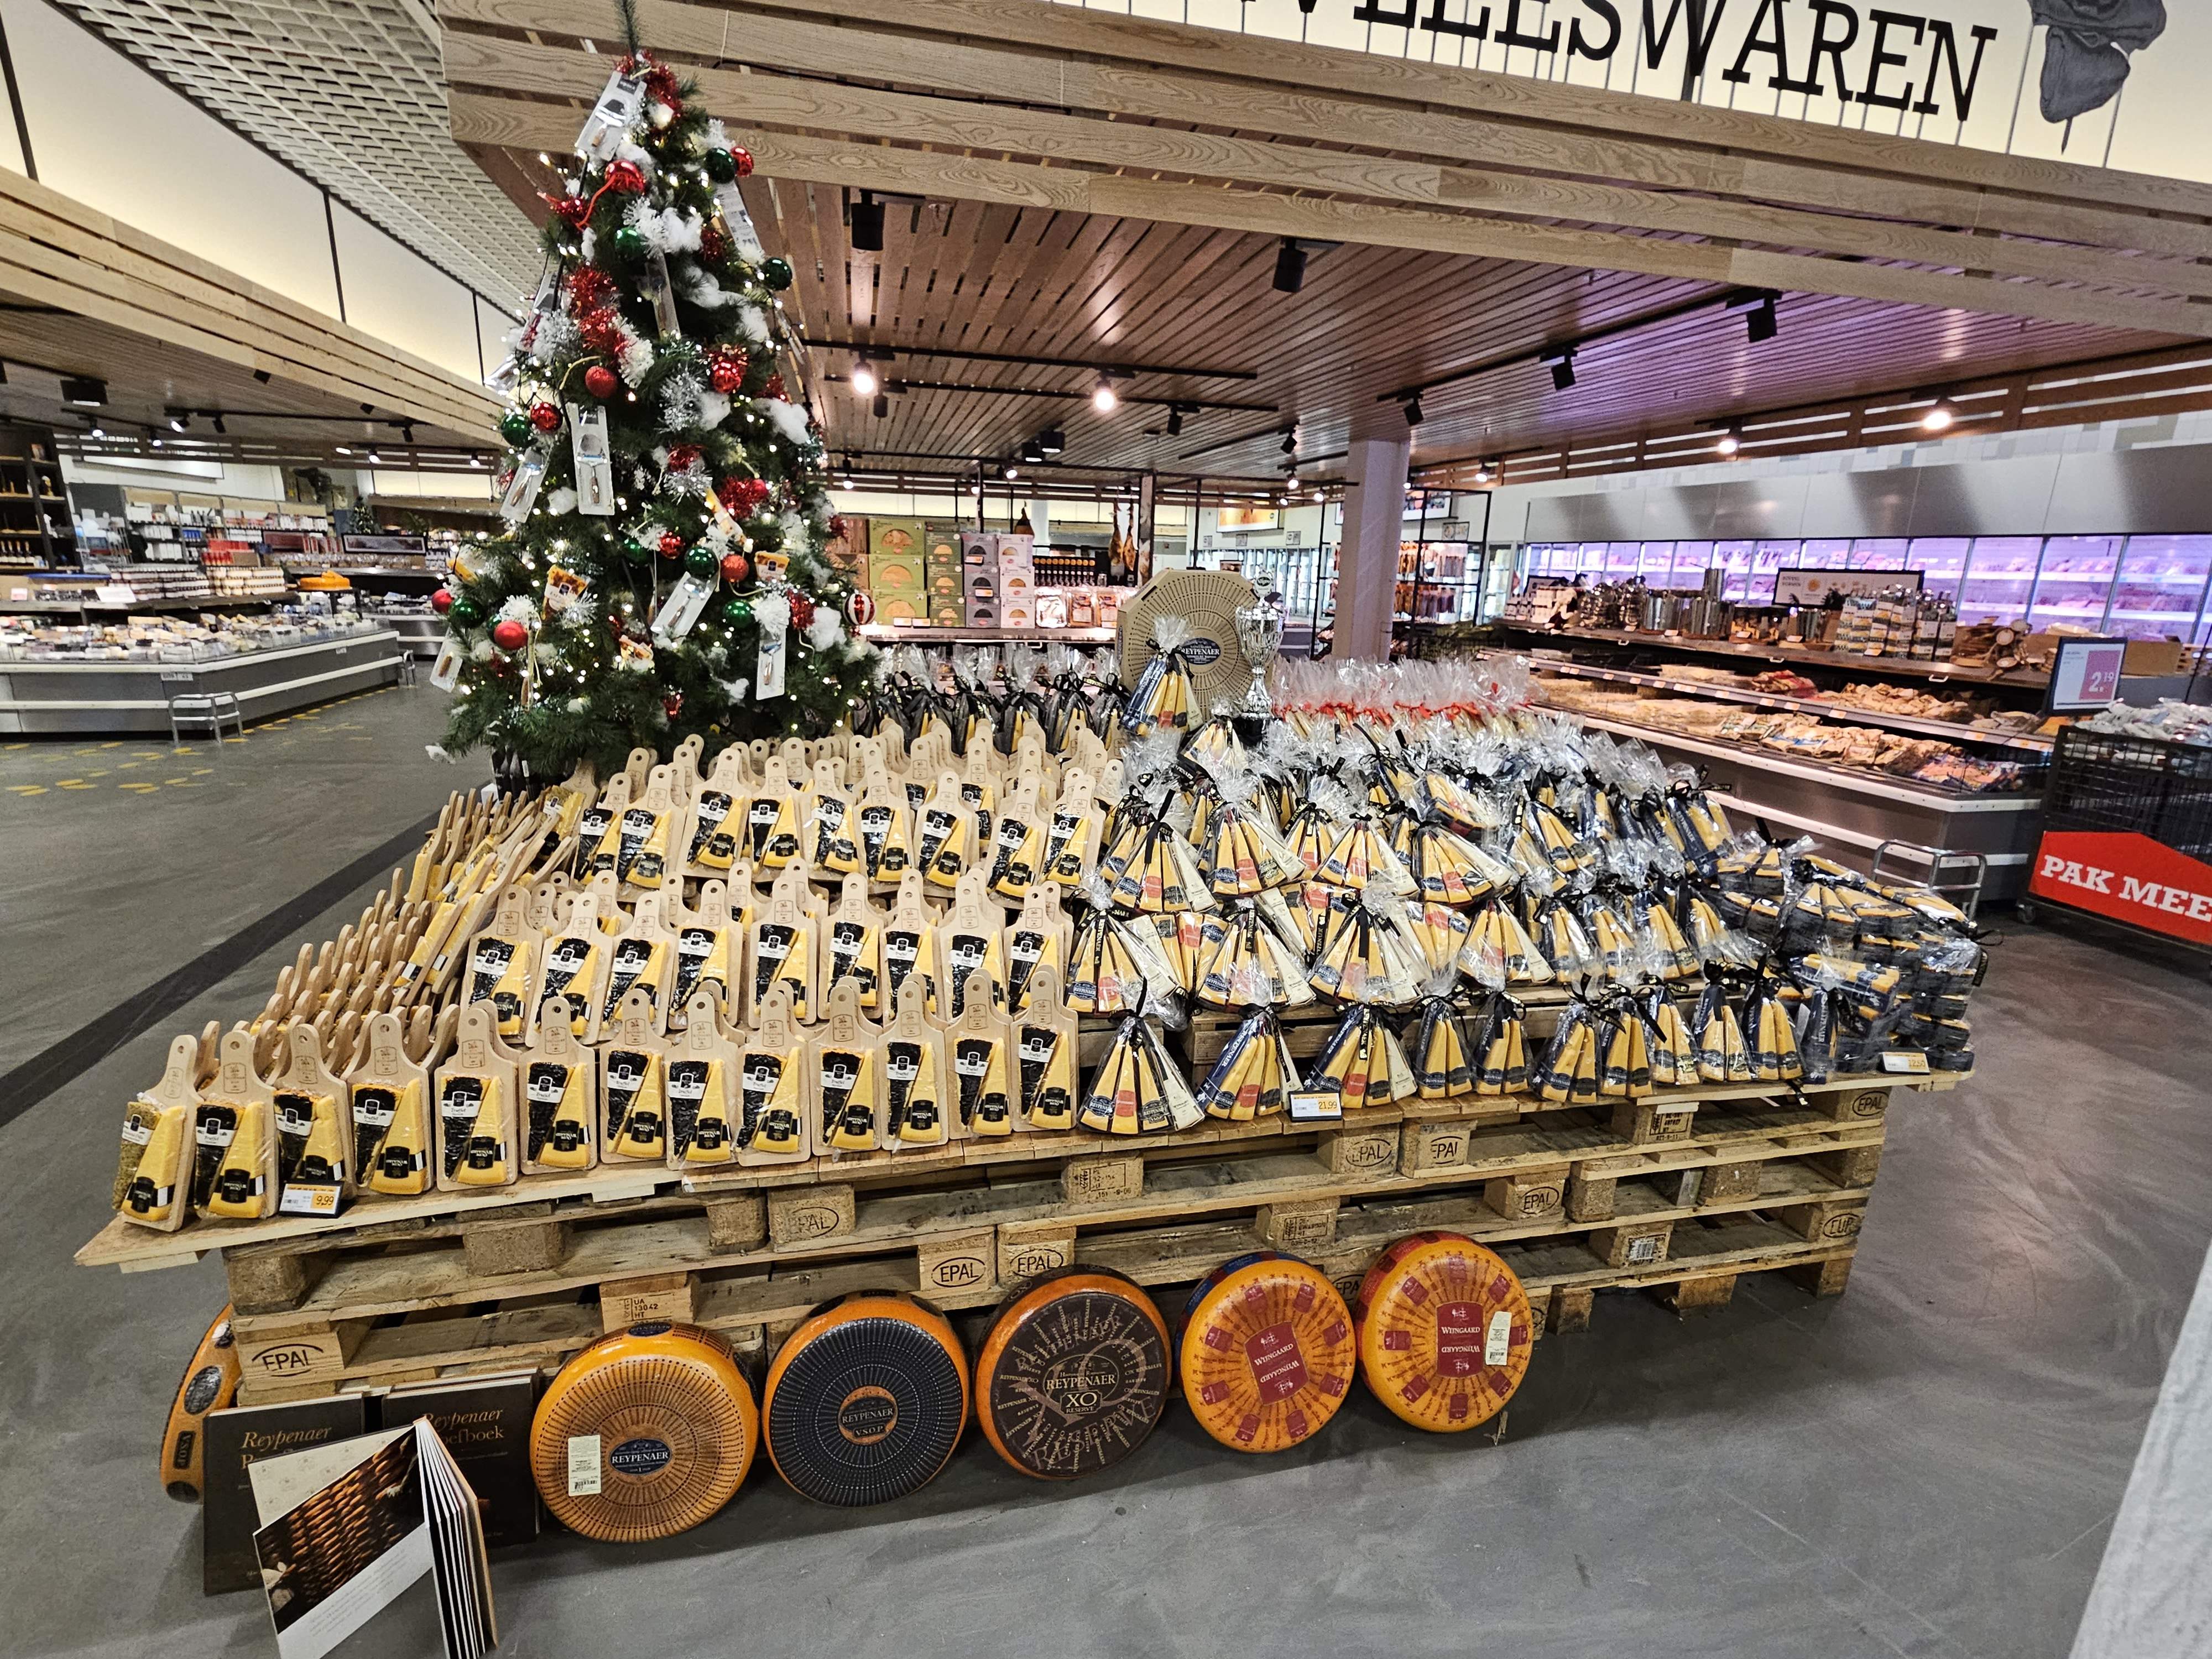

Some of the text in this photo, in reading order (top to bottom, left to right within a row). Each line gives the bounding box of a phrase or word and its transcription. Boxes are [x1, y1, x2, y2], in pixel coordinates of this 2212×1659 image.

[2040, 854, 2212, 922] PAK MEE
[1318, 1100, 1337, 1110] 21,99
[1858, 1096, 1884, 1111] EPAL
[316, 1195, 334, 1206] 9,99
[1524, 1192, 1552, 1211] EPAL
[941, 1262, 979, 1282] EPAL
[1018, 1255, 1056, 1272] EPAL
[1254, 1343, 1294, 1366] WIJNGAARD
[1260, 1360, 1300, 1383] WIJNGAARD
[1046, 1374, 1116, 1390] REYPENAER
[1066, 1392, 1098, 1407] XO
[842, 1408, 894, 1423] REYPENAER
[241, 1426, 332, 1452] Reypenaer
[444, 1425, 504, 1446] oefboek
[612, 1451, 669, 1464] REYPENAER
